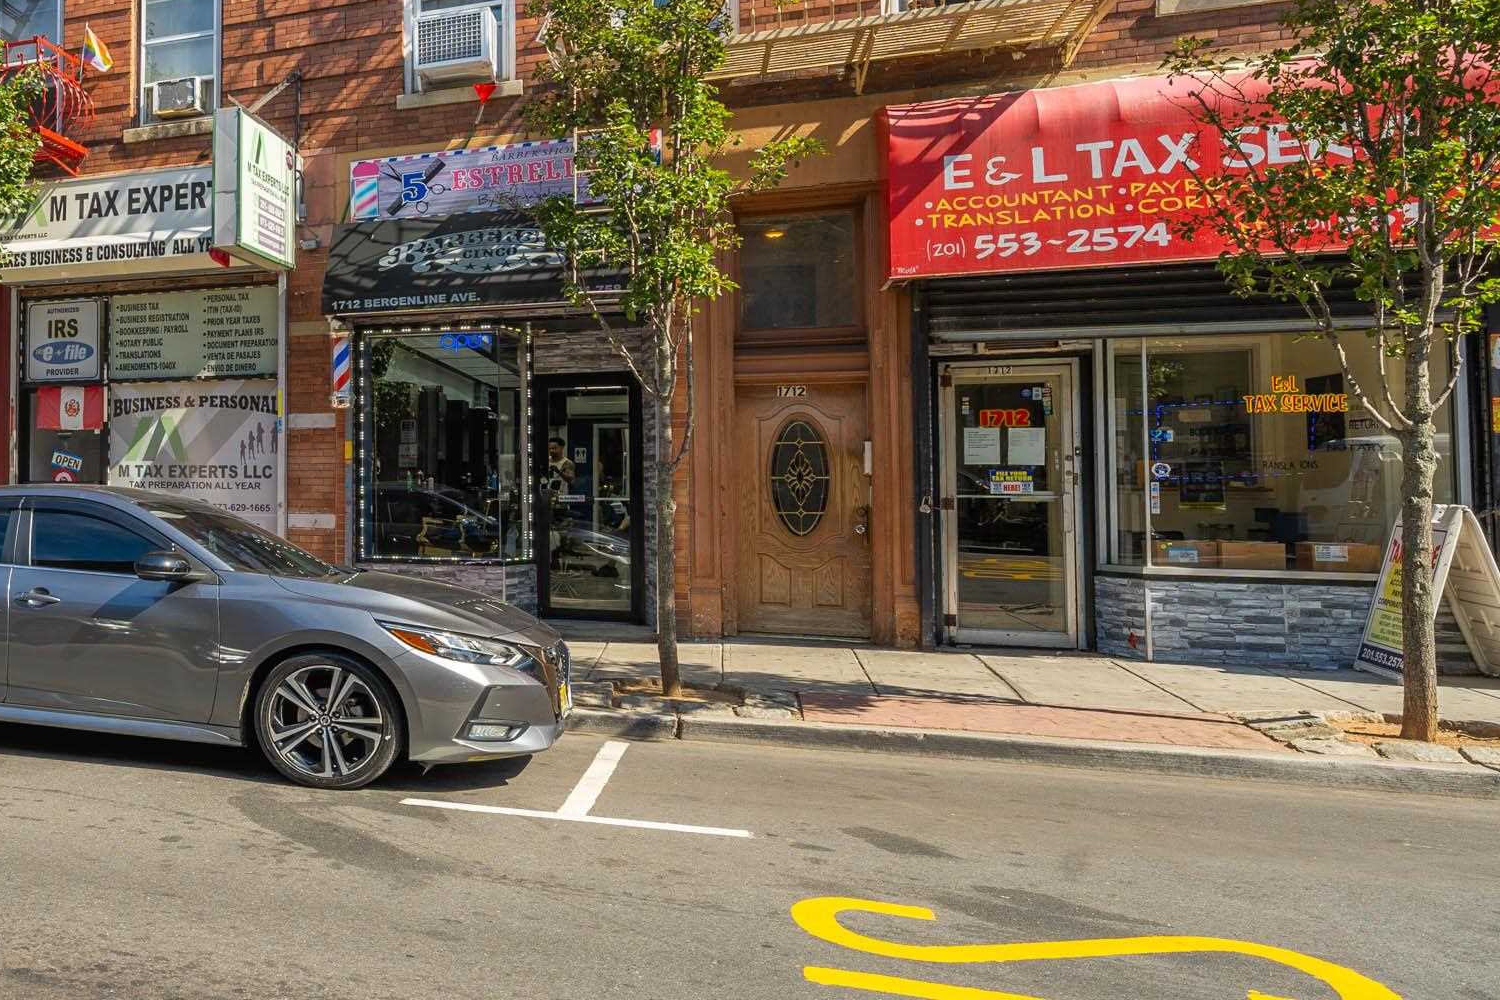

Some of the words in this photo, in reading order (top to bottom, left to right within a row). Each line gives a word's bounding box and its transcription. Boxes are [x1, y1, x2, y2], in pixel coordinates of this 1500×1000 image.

[943, 153, 974, 191] E
[985, 156, 1023, 186] &
[1031, 146, 1068, 184] L
[1075, 132, 1201, 180] TAX
[451, 157, 577, 191] ESTRELL
[400, 170, 429, 205] 5
[49, 195, 67, 223] M
[75, 189, 120, 220] TAX
[127, 181, 212, 216] EXPER
[935, 185, 1113, 212] ACCOUNTANT
[928, 203, 1115, 230] TRANSLATION
[30, 248, 83, 266] BUSINESS
[86, 246, 93, 261] &
[96, 240, 166, 262] CONSULTING
[172, 239, 195, 255] ALL
[198, 237, 212, 253] YE
[462, 246, 518, 260] CINCO
[926, 237, 966, 261] (201)
[207, 294, 236, 303] PERSONAL
[238, 293, 249, 301] TAX
[331, 299, 361, 311] 1712
[364, 295, 446, 309] BERGENLINE
[449, 292, 481, 305] AVE.
[47, 306, 80, 314] AUTHORIZED
[120, 304, 148, 312] BUSINESS
[149, 302, 159, 310] TAX
[120, 316, 147, 324] BUSINESS
[148, 313, 189, 323] REGISTRATION
[207, 317, 224, 326] PRIOR
[226, 316, 241, 325] YEAR
[242, 315, 260, 324] TAXES
[48, 318, 78, 339] IRS
[119, 327, 159, 336] BOOKKEEPING
[164, 325, 188, 334] PAYROLL
[207, 330, 233, 338] PAYMENT
[234, 329, 253, 337] PLANS
[254, 328, 264, 336] IRS
[119, 339, 141, 348] NOTARY
[142, 338, 163, 346] PUBLIC
[207, 341, 239, 350] DOCUMENT
[119, 350, 161, 359] TRANSLATIONS
[207, 352, 226, 361] VENTA
[227, 352, 235, 360] DE
[235, 351, 261, 359] PASAJES
[46, 368, 80, 377] PROVIDER
[207, 364, 224, 373] ENVIO
[226, 364, 234, 372] DE
[234, 363, 257, 372] DINERO
[778, 386, 805, 397] 1712
[112, 396, 181, 418] BUSINESS
[184, 395, 196, 408] &
[1243, 394, 1276, 414] TAX
[1280, 393, 1349, 413] SERVICE
[980, 409, 1030, 428] 1712
[55, 454, 80, 469] OPEN
[1262, 460, 1318, 470] RANSLAIONS
[118, 465, 129, 478] M
[135, 465, 167, 479] TAX
[169, 465, 238, 479] EXPERTS
[244, 464, 273, 479] LLC
[129, 481, 146, 489] TAX
[148, 480, 212, 490] PREPARATION
[214, 480, 232, 490] ALL
[234, 480, 261, 490] YEAR
